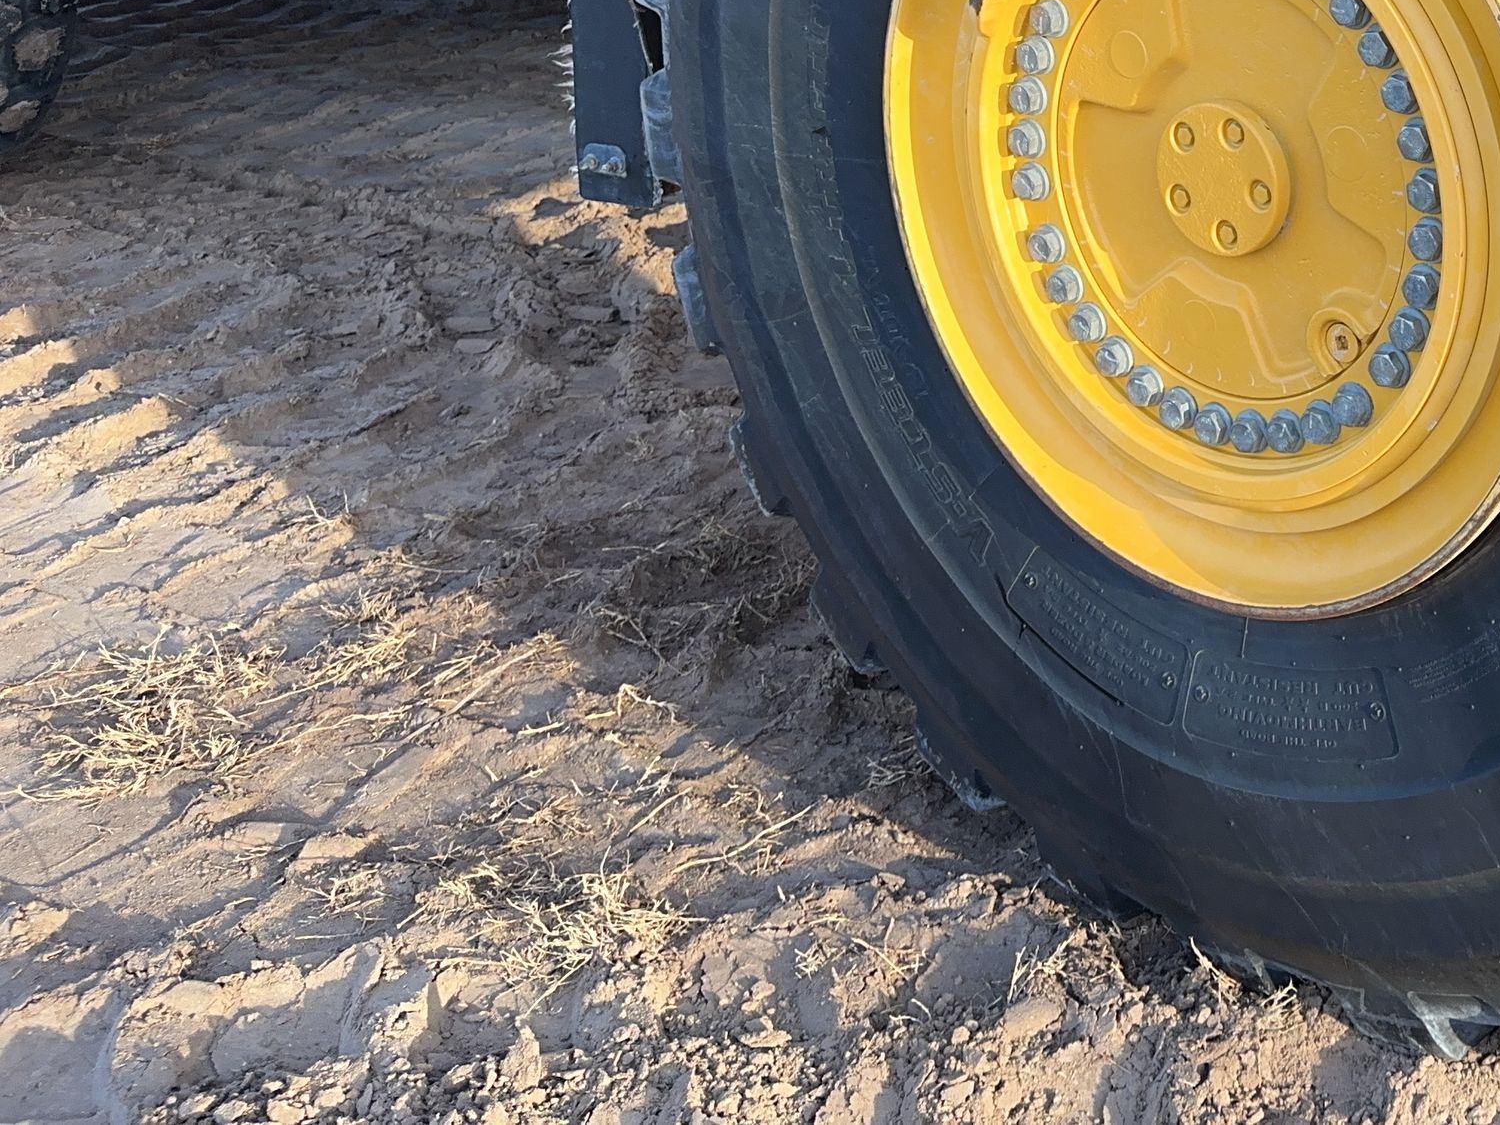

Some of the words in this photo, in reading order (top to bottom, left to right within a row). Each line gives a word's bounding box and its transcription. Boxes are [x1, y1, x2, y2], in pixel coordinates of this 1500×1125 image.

[849, 305, 998, 567] V-STEEL
[1040, 564, 1129, 639] RESISTANT
[1137, 637, 1174, 665] CUT
[1208, 664, 1320, 696] RESISTANT
[1332, 681, 1374, 696] CUT
[1216, 703, 1366, 733] EARTHMOVING
